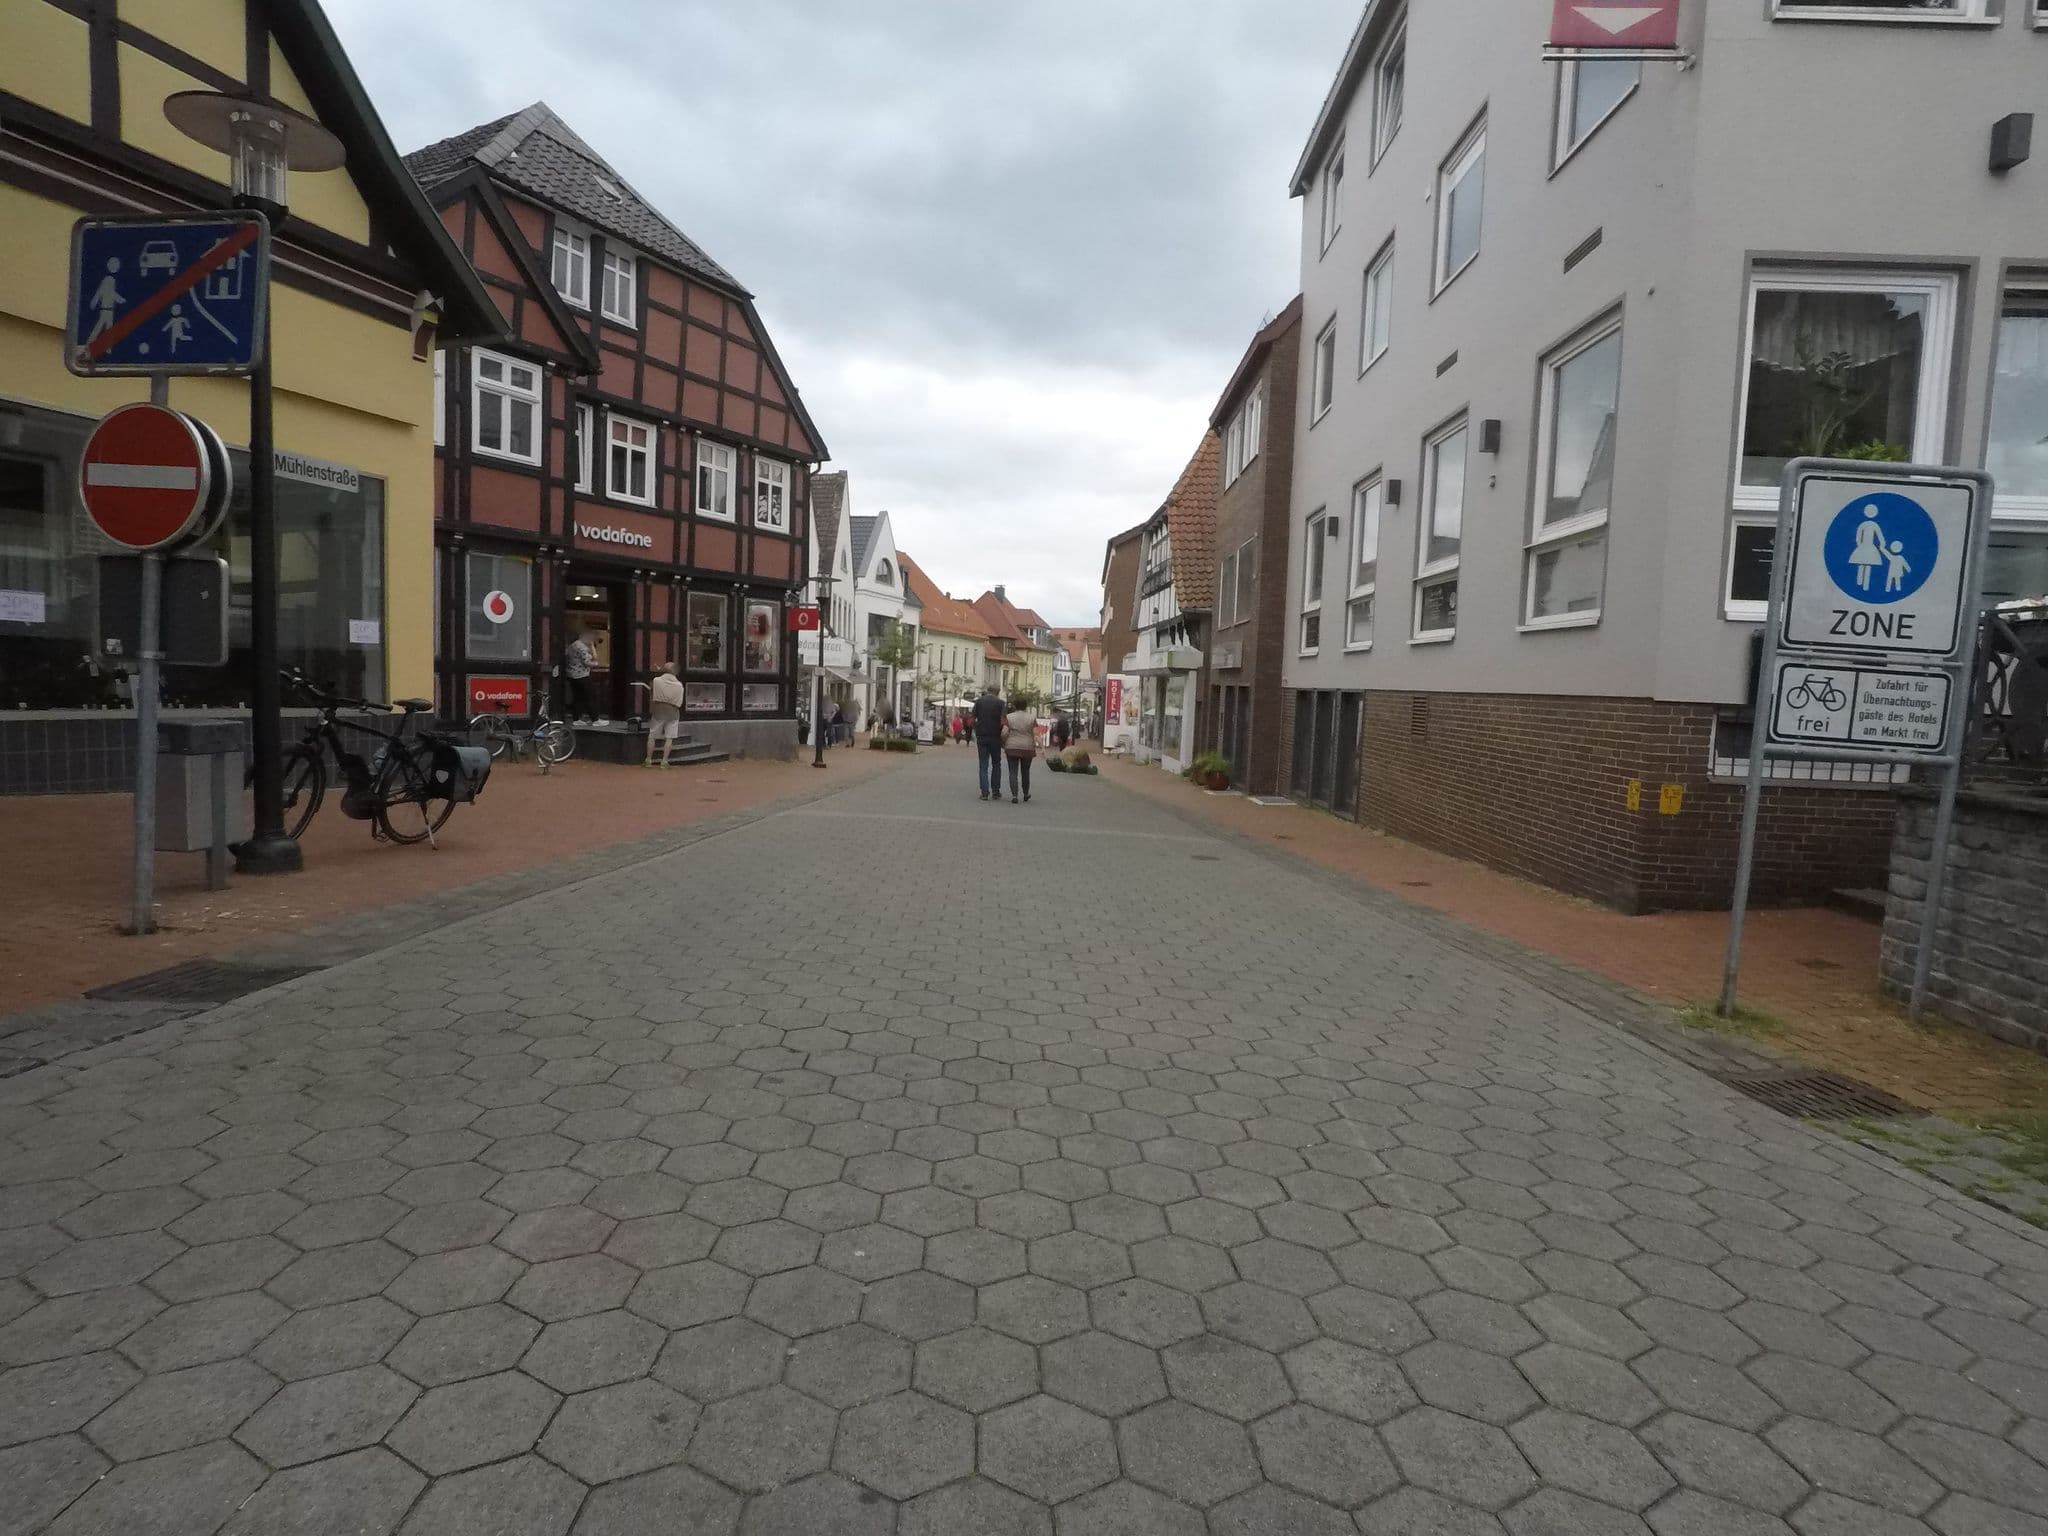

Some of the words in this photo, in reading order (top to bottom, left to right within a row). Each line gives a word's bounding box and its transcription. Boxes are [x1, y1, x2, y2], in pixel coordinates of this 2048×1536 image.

[275, 454, 357, 487] Mühlenstraße
[580, 525, 653, 547] vodafone
[1829, 609, 1917, 640] ZONE
[1876, 679, 1910, 692] Zufahrt
[1914, 681, 1929, 692] für
[486, 692, 523, 700] vodafone
[1863, 691, 1938, 711] Übernachtungs-
[1797, 715, 1830, 733] frei
[1858, 708, 1884, 722] gäste
[1887, 711, 1904, 722] des
[1908, 713, 1938, 725] Hotels
[1862, 728, 1878, 736] am
[1880, 726, 1909, 738] Markt
[1912, 728, 1930, 740] frei
